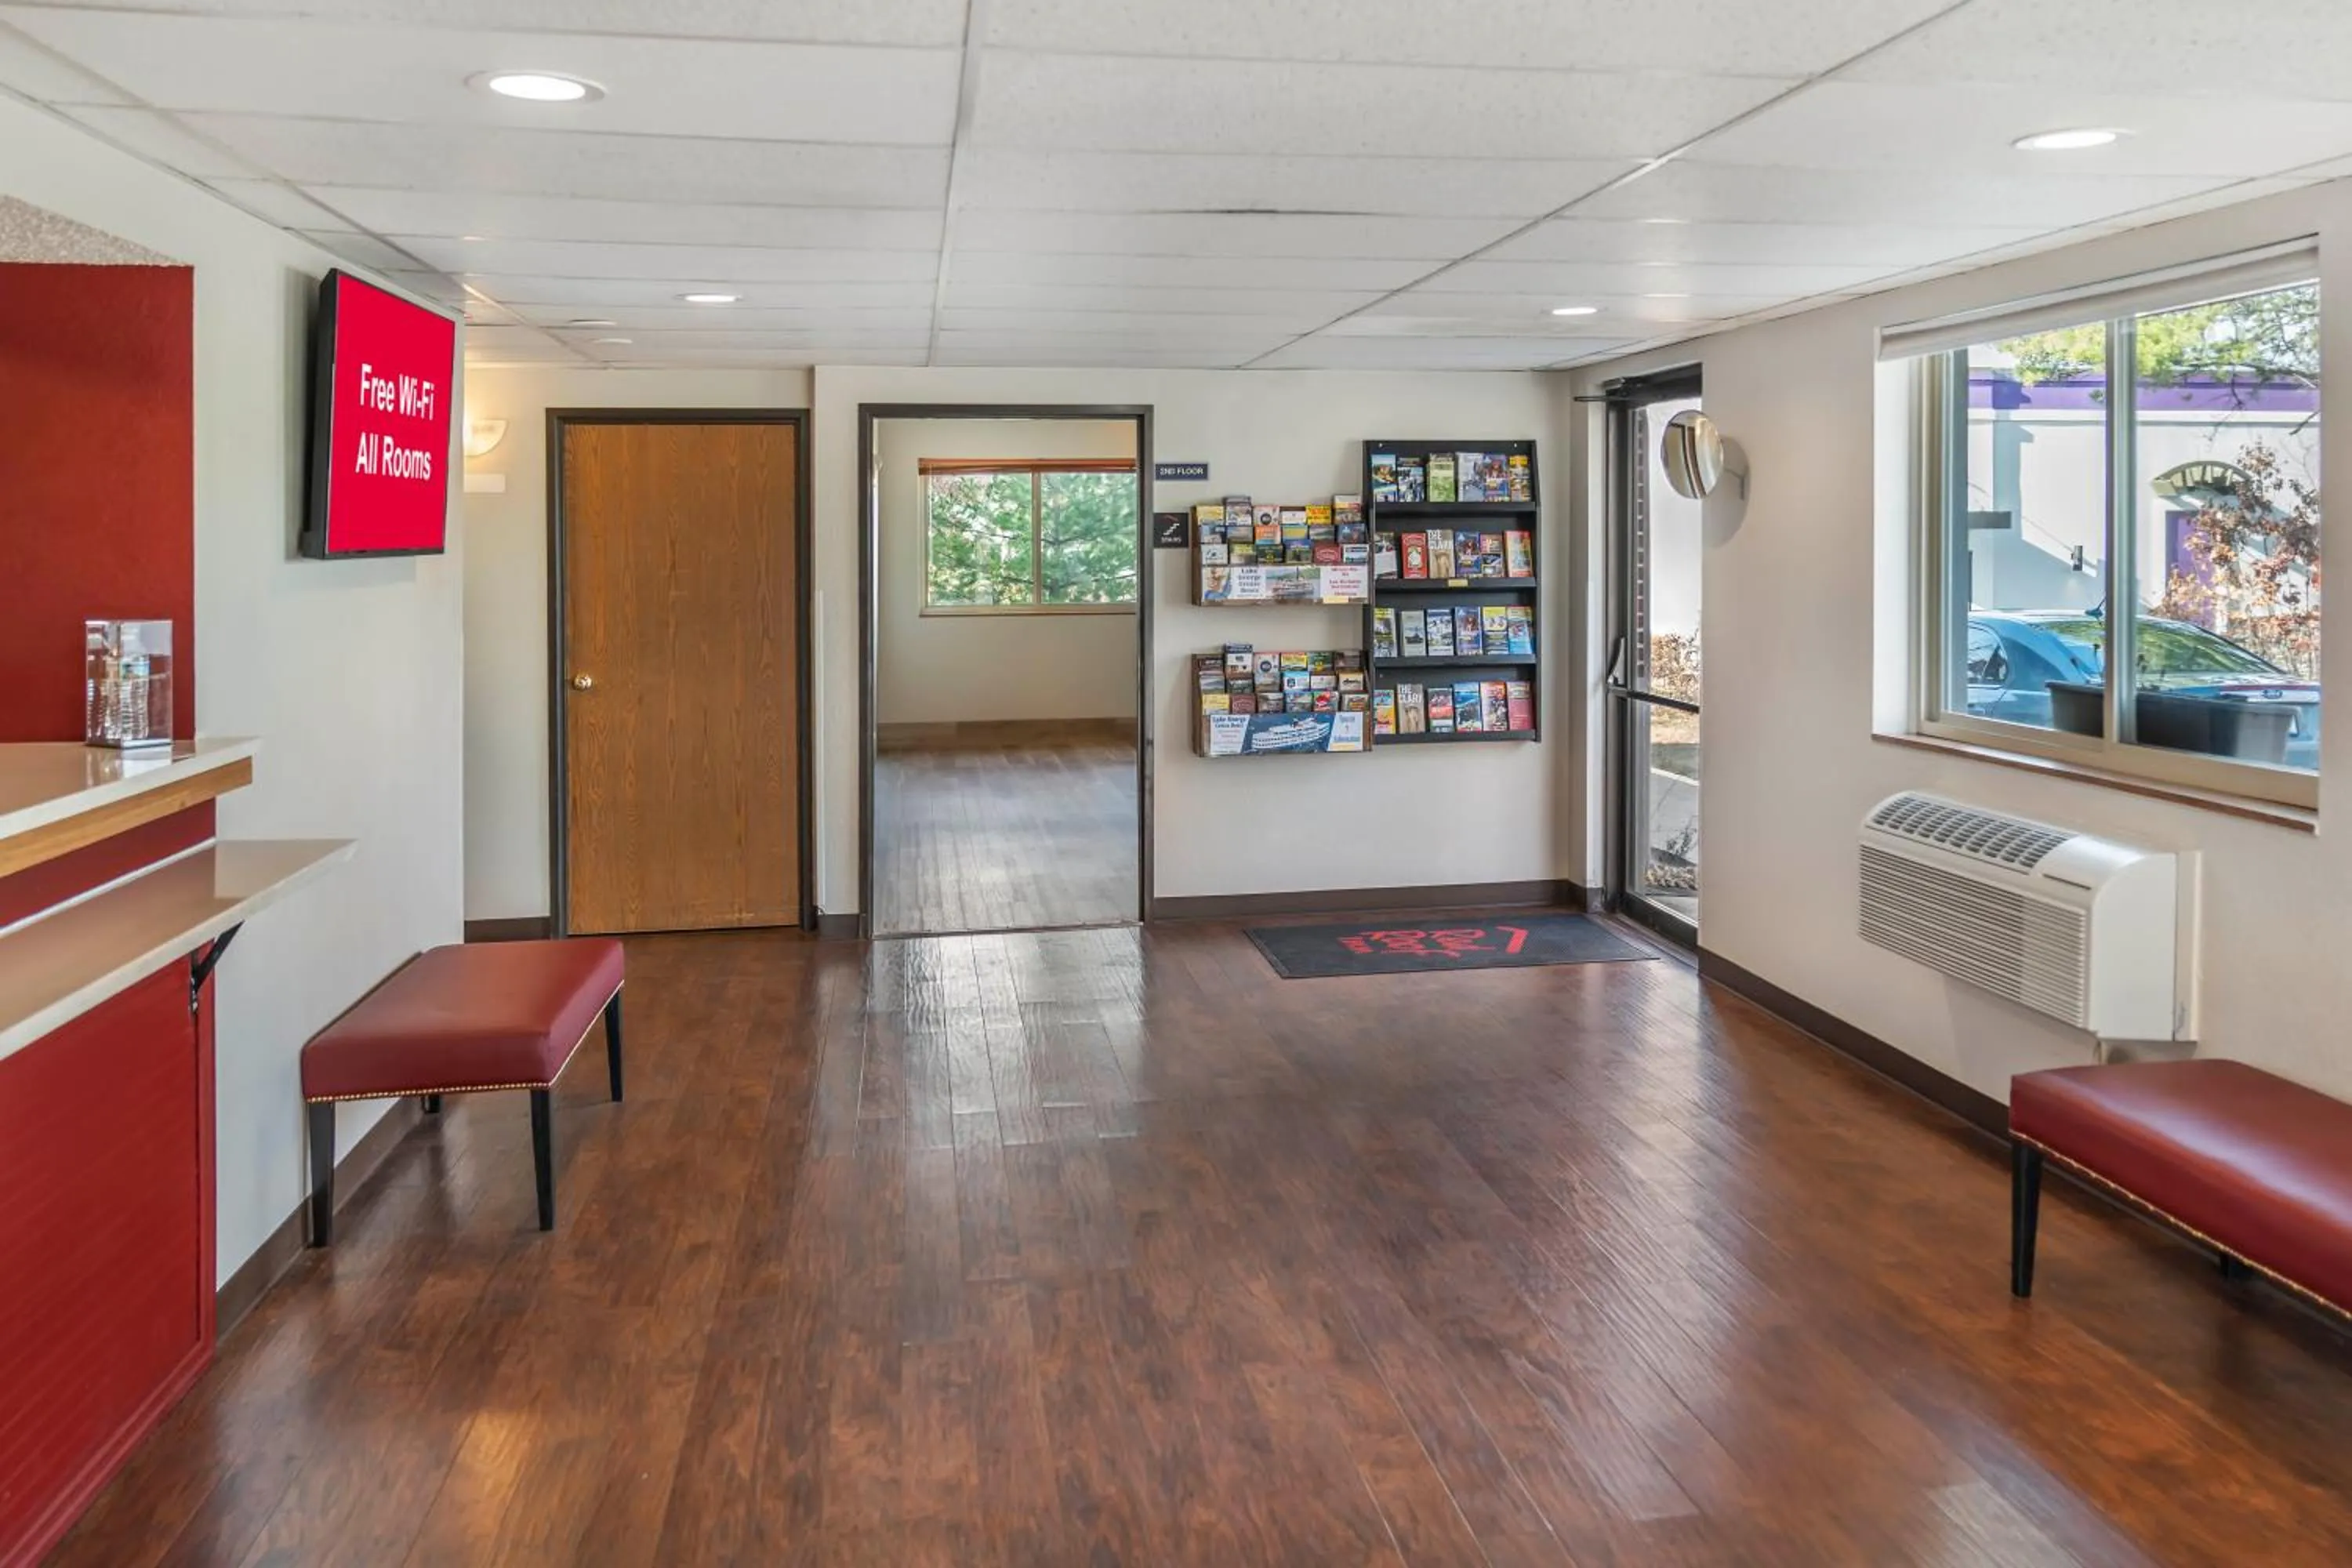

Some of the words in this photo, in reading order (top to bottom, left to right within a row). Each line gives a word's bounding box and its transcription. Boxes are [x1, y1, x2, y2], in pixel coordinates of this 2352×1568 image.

[360, 363, 394, 412] Free
[398, 373, 436, 421] Wi-Fi
[355, 431, 379, 475] All
[382, 435, 431, 481] Rooms
[1177, 466, 1204, 475] FLOOR
